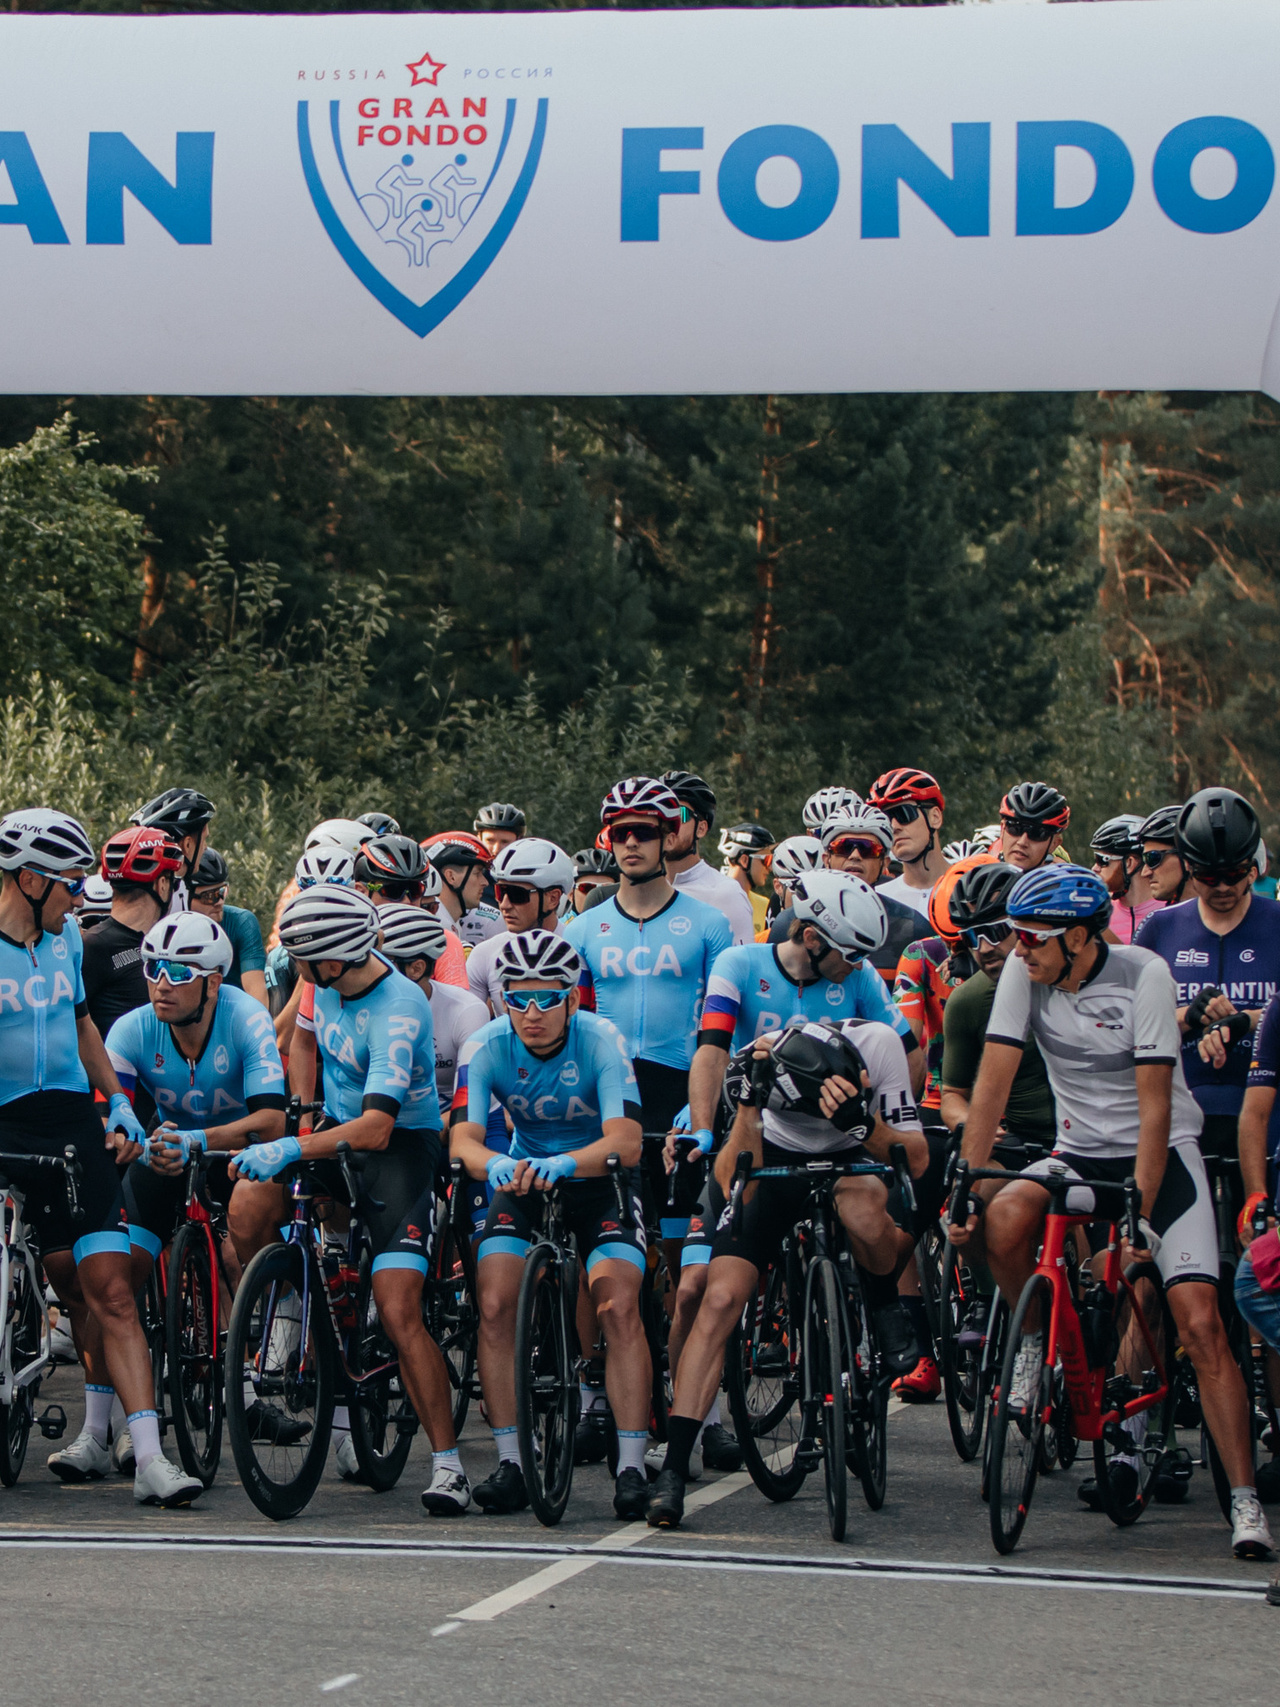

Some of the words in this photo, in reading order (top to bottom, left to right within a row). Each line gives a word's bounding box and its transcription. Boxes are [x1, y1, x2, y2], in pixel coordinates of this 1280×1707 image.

[298, 69, 386, 80] RUSSIA
[463, 67, 553, 79] РОССИЯ
[358, 97, 487, 118] GRAN
[358, 124, 487, 146] FONDO
[620, 115, 1276, 242] FONDO
[13, 822, 43, 835] KASK
[138, 839, 165, 848] KASK
[823, 912, 839, 930] 063
[294, 935, 313, 943] GIRO
[601, 945, 682, 978] RCA
[246, 1010, 285, 1085] RCA
[384, 1014, 420, 1089] RCA
[153, 1087, 245, 1116] RCA
[506, 1094, 599, 1122] RCA
